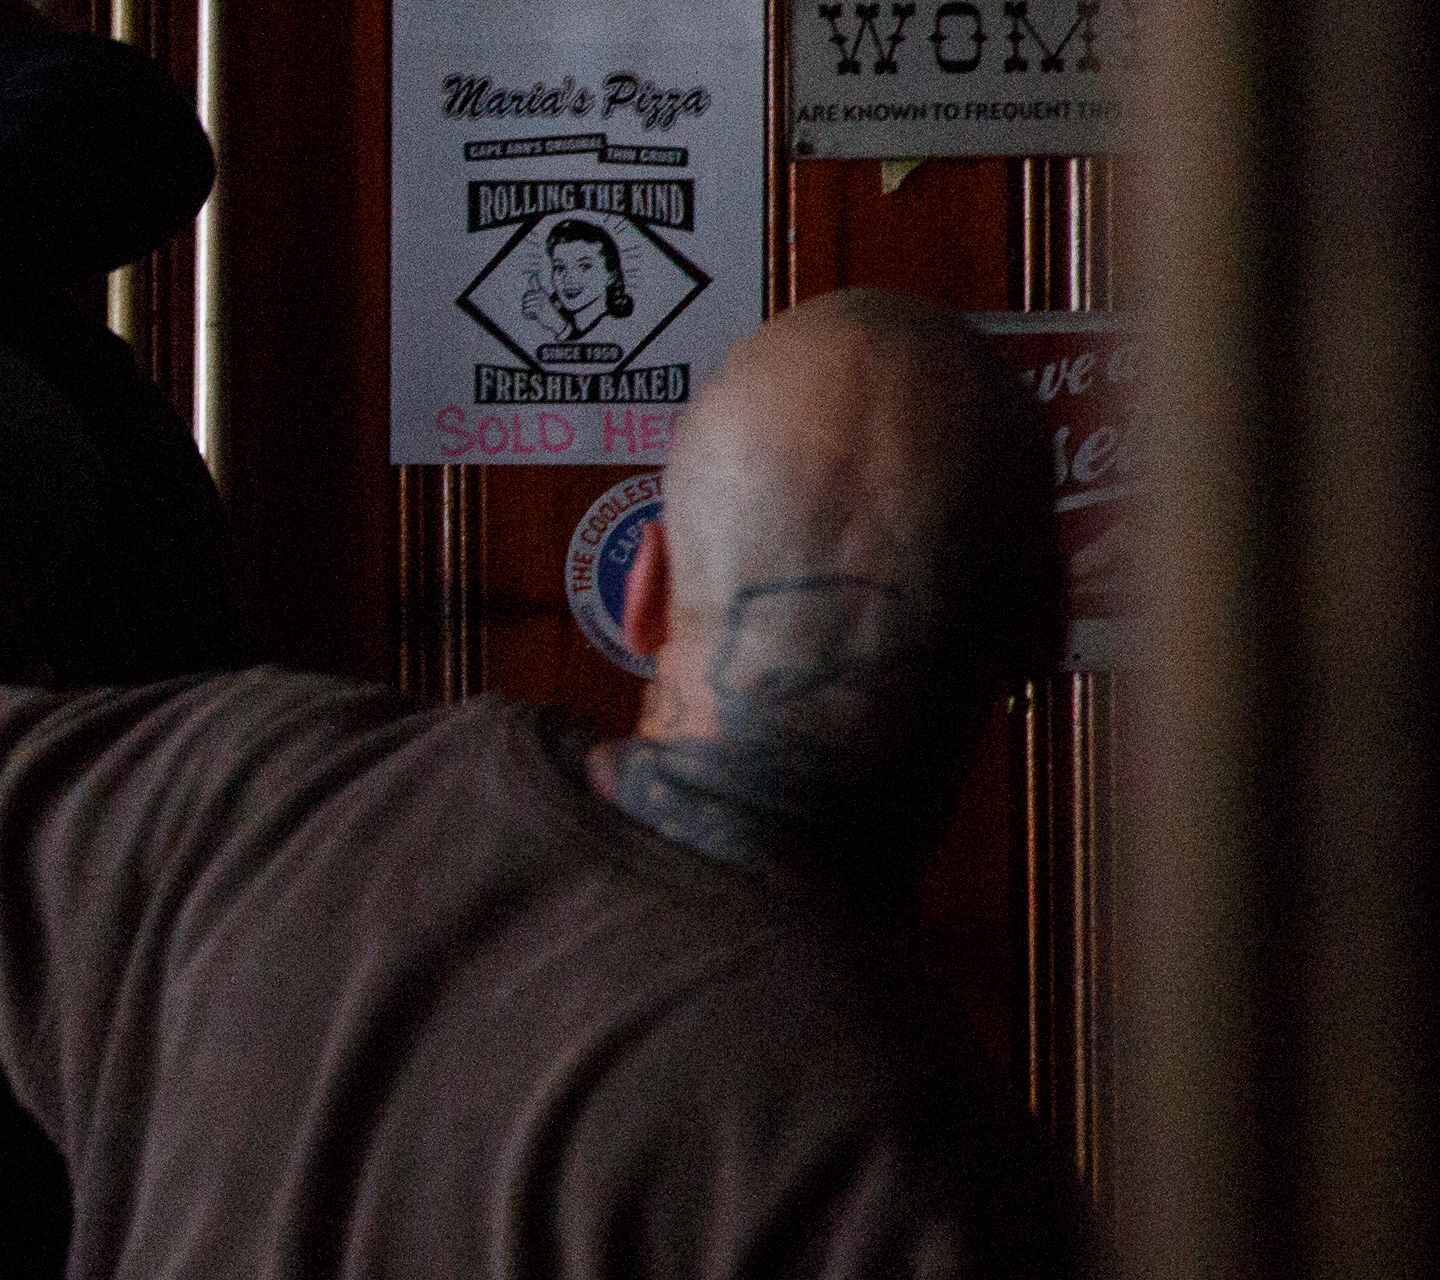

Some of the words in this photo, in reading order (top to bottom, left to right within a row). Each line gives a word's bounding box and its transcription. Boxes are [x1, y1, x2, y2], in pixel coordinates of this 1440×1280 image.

[818, 0, 1112, 74] WOM
[442, 74, 592, 119] Maria's
[603, 73, 711, 130] Pizza
[797, 105, 838, 122] ARE
[843, 103, 927, 121] KNOWN
[930, 102, 960, 120] TO
[964, 101, 1073, 121] FREQUENT
[479, 182, 578, 226] ROLLING
[581, 182, 628, 212] THE
[631, 182, 687, 225] KIND
[480, 368, 596, 403] FRESHLY
[598, 367, 686, 402] BAKED
[435, 404, 577, 458] SOLD
[581, 476, 664, 547] COOLEST
[572, 551, 595, 595] THE
